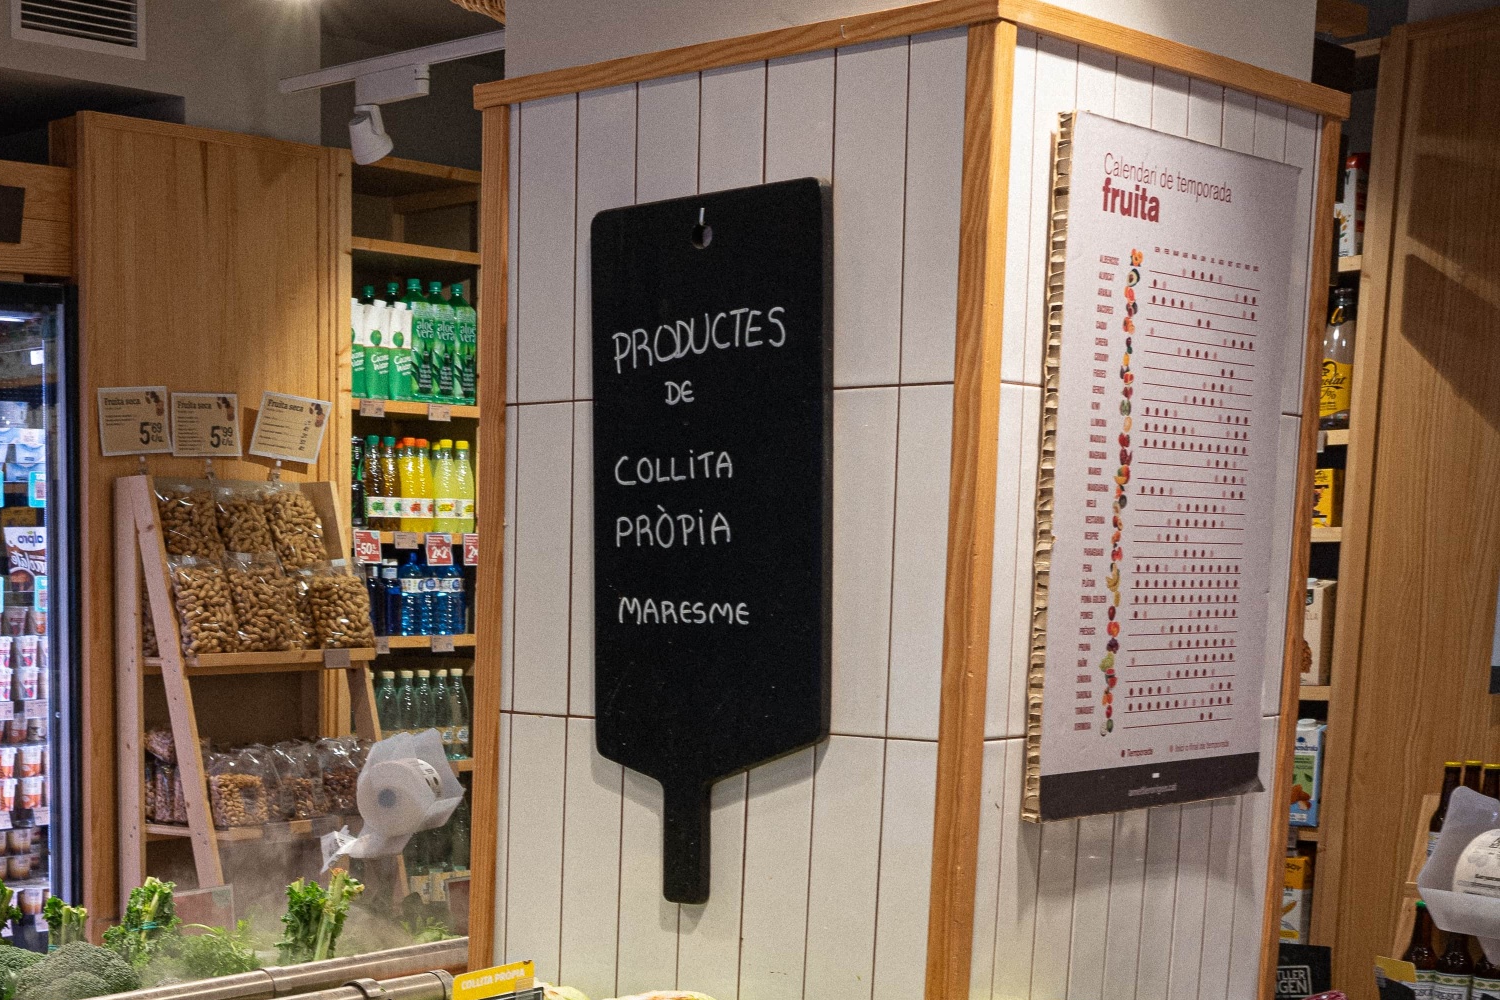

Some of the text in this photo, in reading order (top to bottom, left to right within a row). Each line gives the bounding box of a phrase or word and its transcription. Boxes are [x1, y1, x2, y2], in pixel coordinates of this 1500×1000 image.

[1104, 152, 1232, 203] Calendari de temporada
[1103, 177, 1160, 223] fruita
[612, 307, 786, 374] PRODUCTES
[104, 397, 141, 406] Fruita seca
[177, 401, 212, 410] Fruita seca
[267, 398, 304, 413] Fruita seca
[665, 380, 695, 405] DE
[614, 449, 733, 486] COLLITA
[616, 504, 731, 548] PRÒPIA
[618, 596, 750, 625] MARESME
[461, 974, 498, 991] COLLITA
